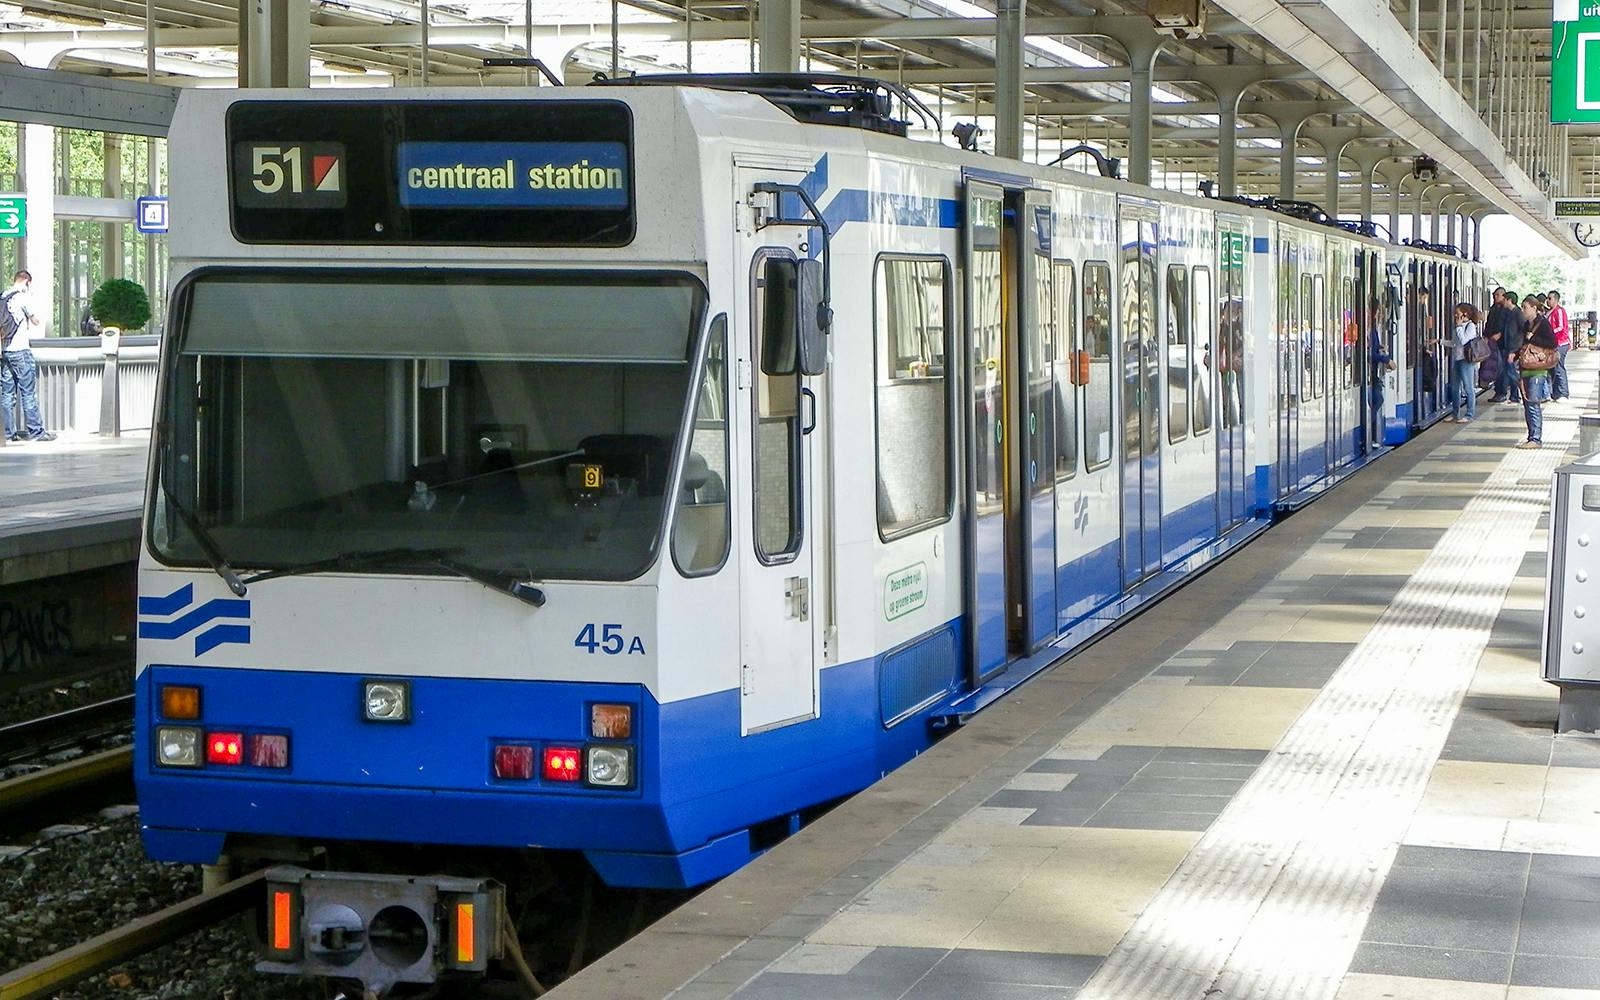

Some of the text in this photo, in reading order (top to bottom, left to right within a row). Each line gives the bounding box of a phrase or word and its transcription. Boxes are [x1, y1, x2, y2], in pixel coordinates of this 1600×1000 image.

[252, 146, 303, 194] 51
[407, 159, 623, 189] centraal station
[587, 472, 596, 486] 9
